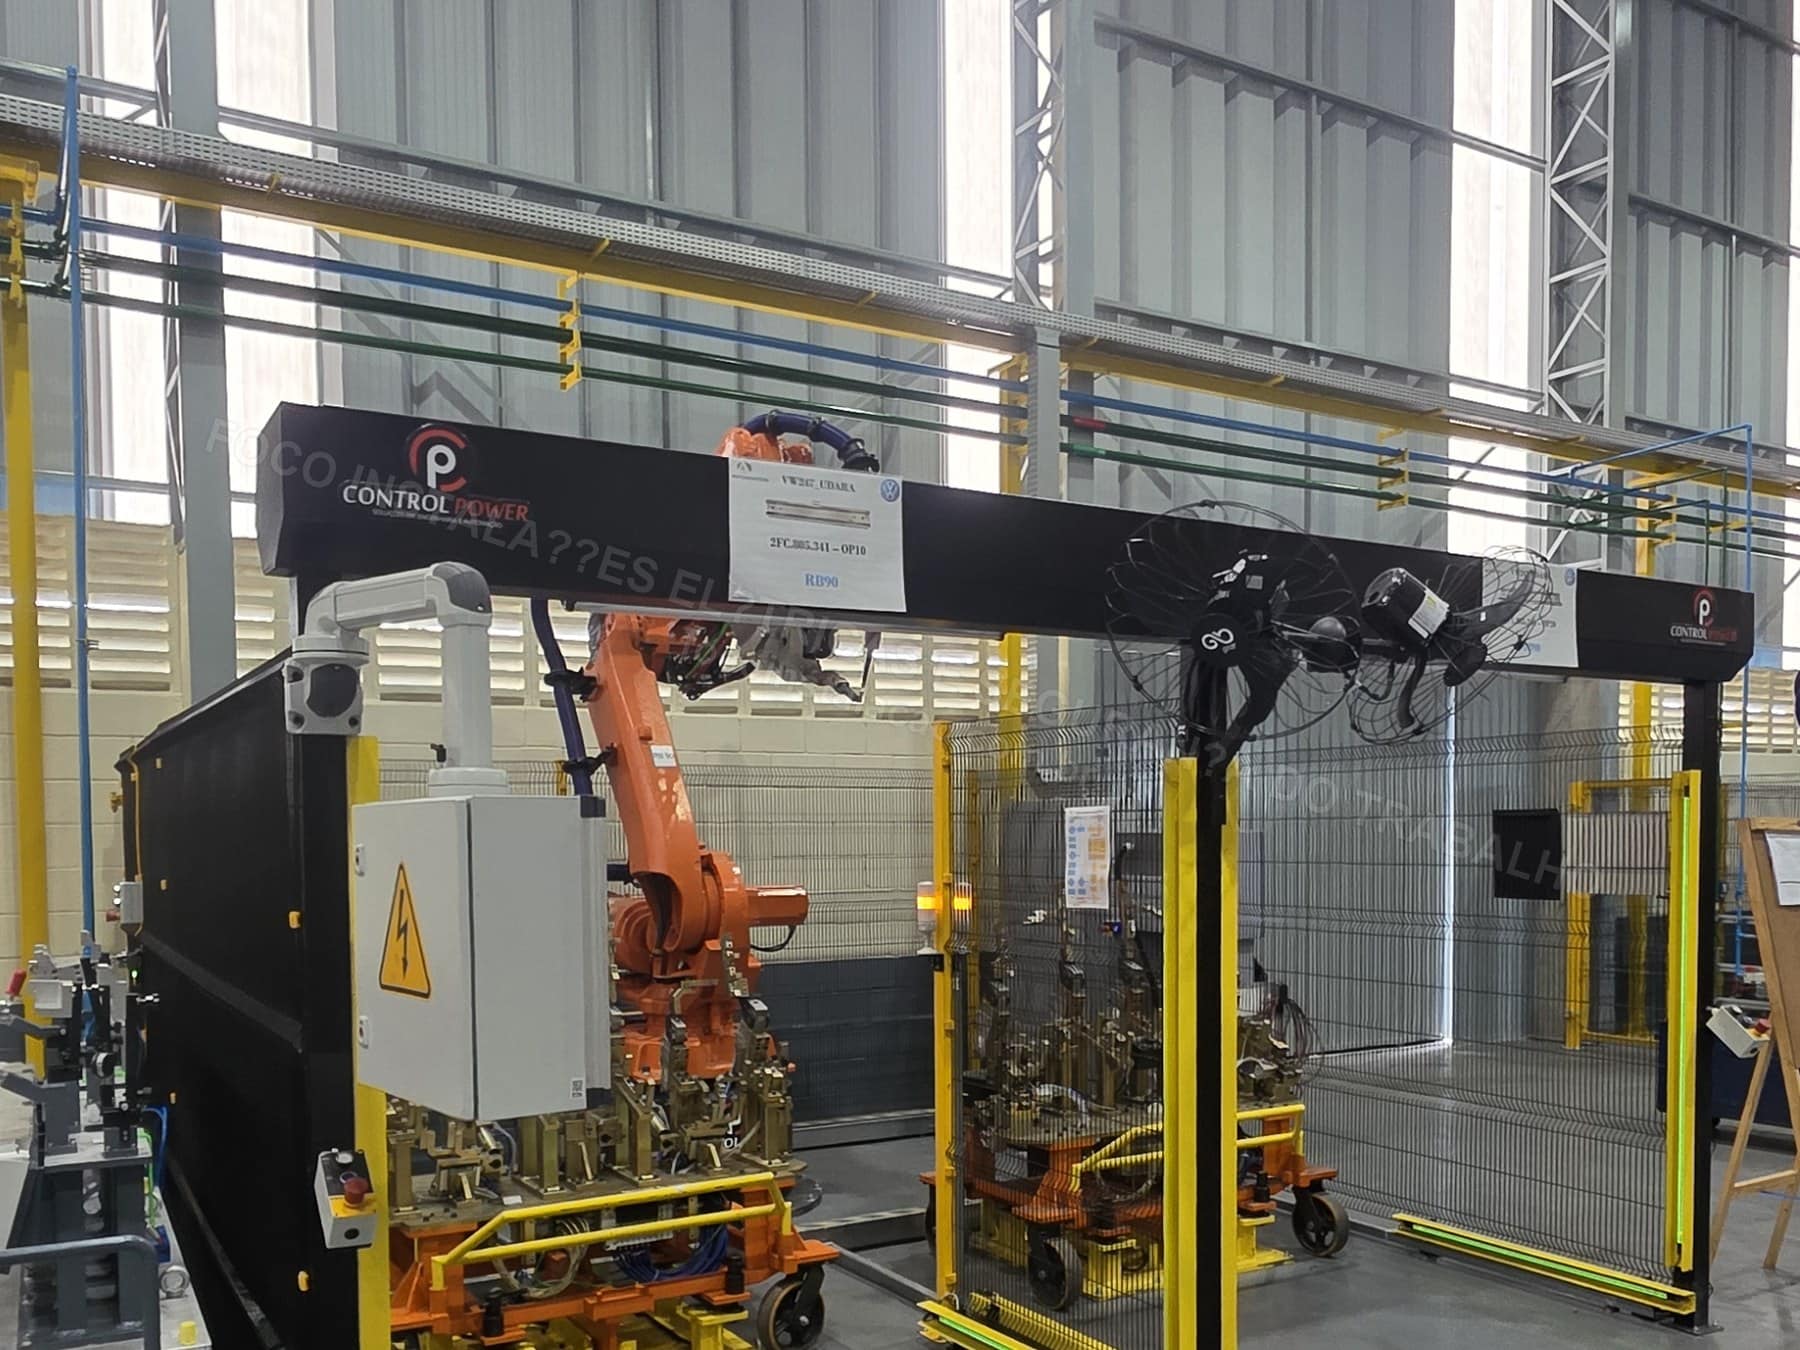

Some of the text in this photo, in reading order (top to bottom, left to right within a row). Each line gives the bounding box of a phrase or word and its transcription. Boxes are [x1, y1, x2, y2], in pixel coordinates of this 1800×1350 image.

[343, 485, 449, 514] CONTROL
[454, 497, 529, 522] POWER
[841, 543, 866, 555] OP10
[805, 573, 838, 588] RB90
[1670, 625, 1707, 641] CONTROL
